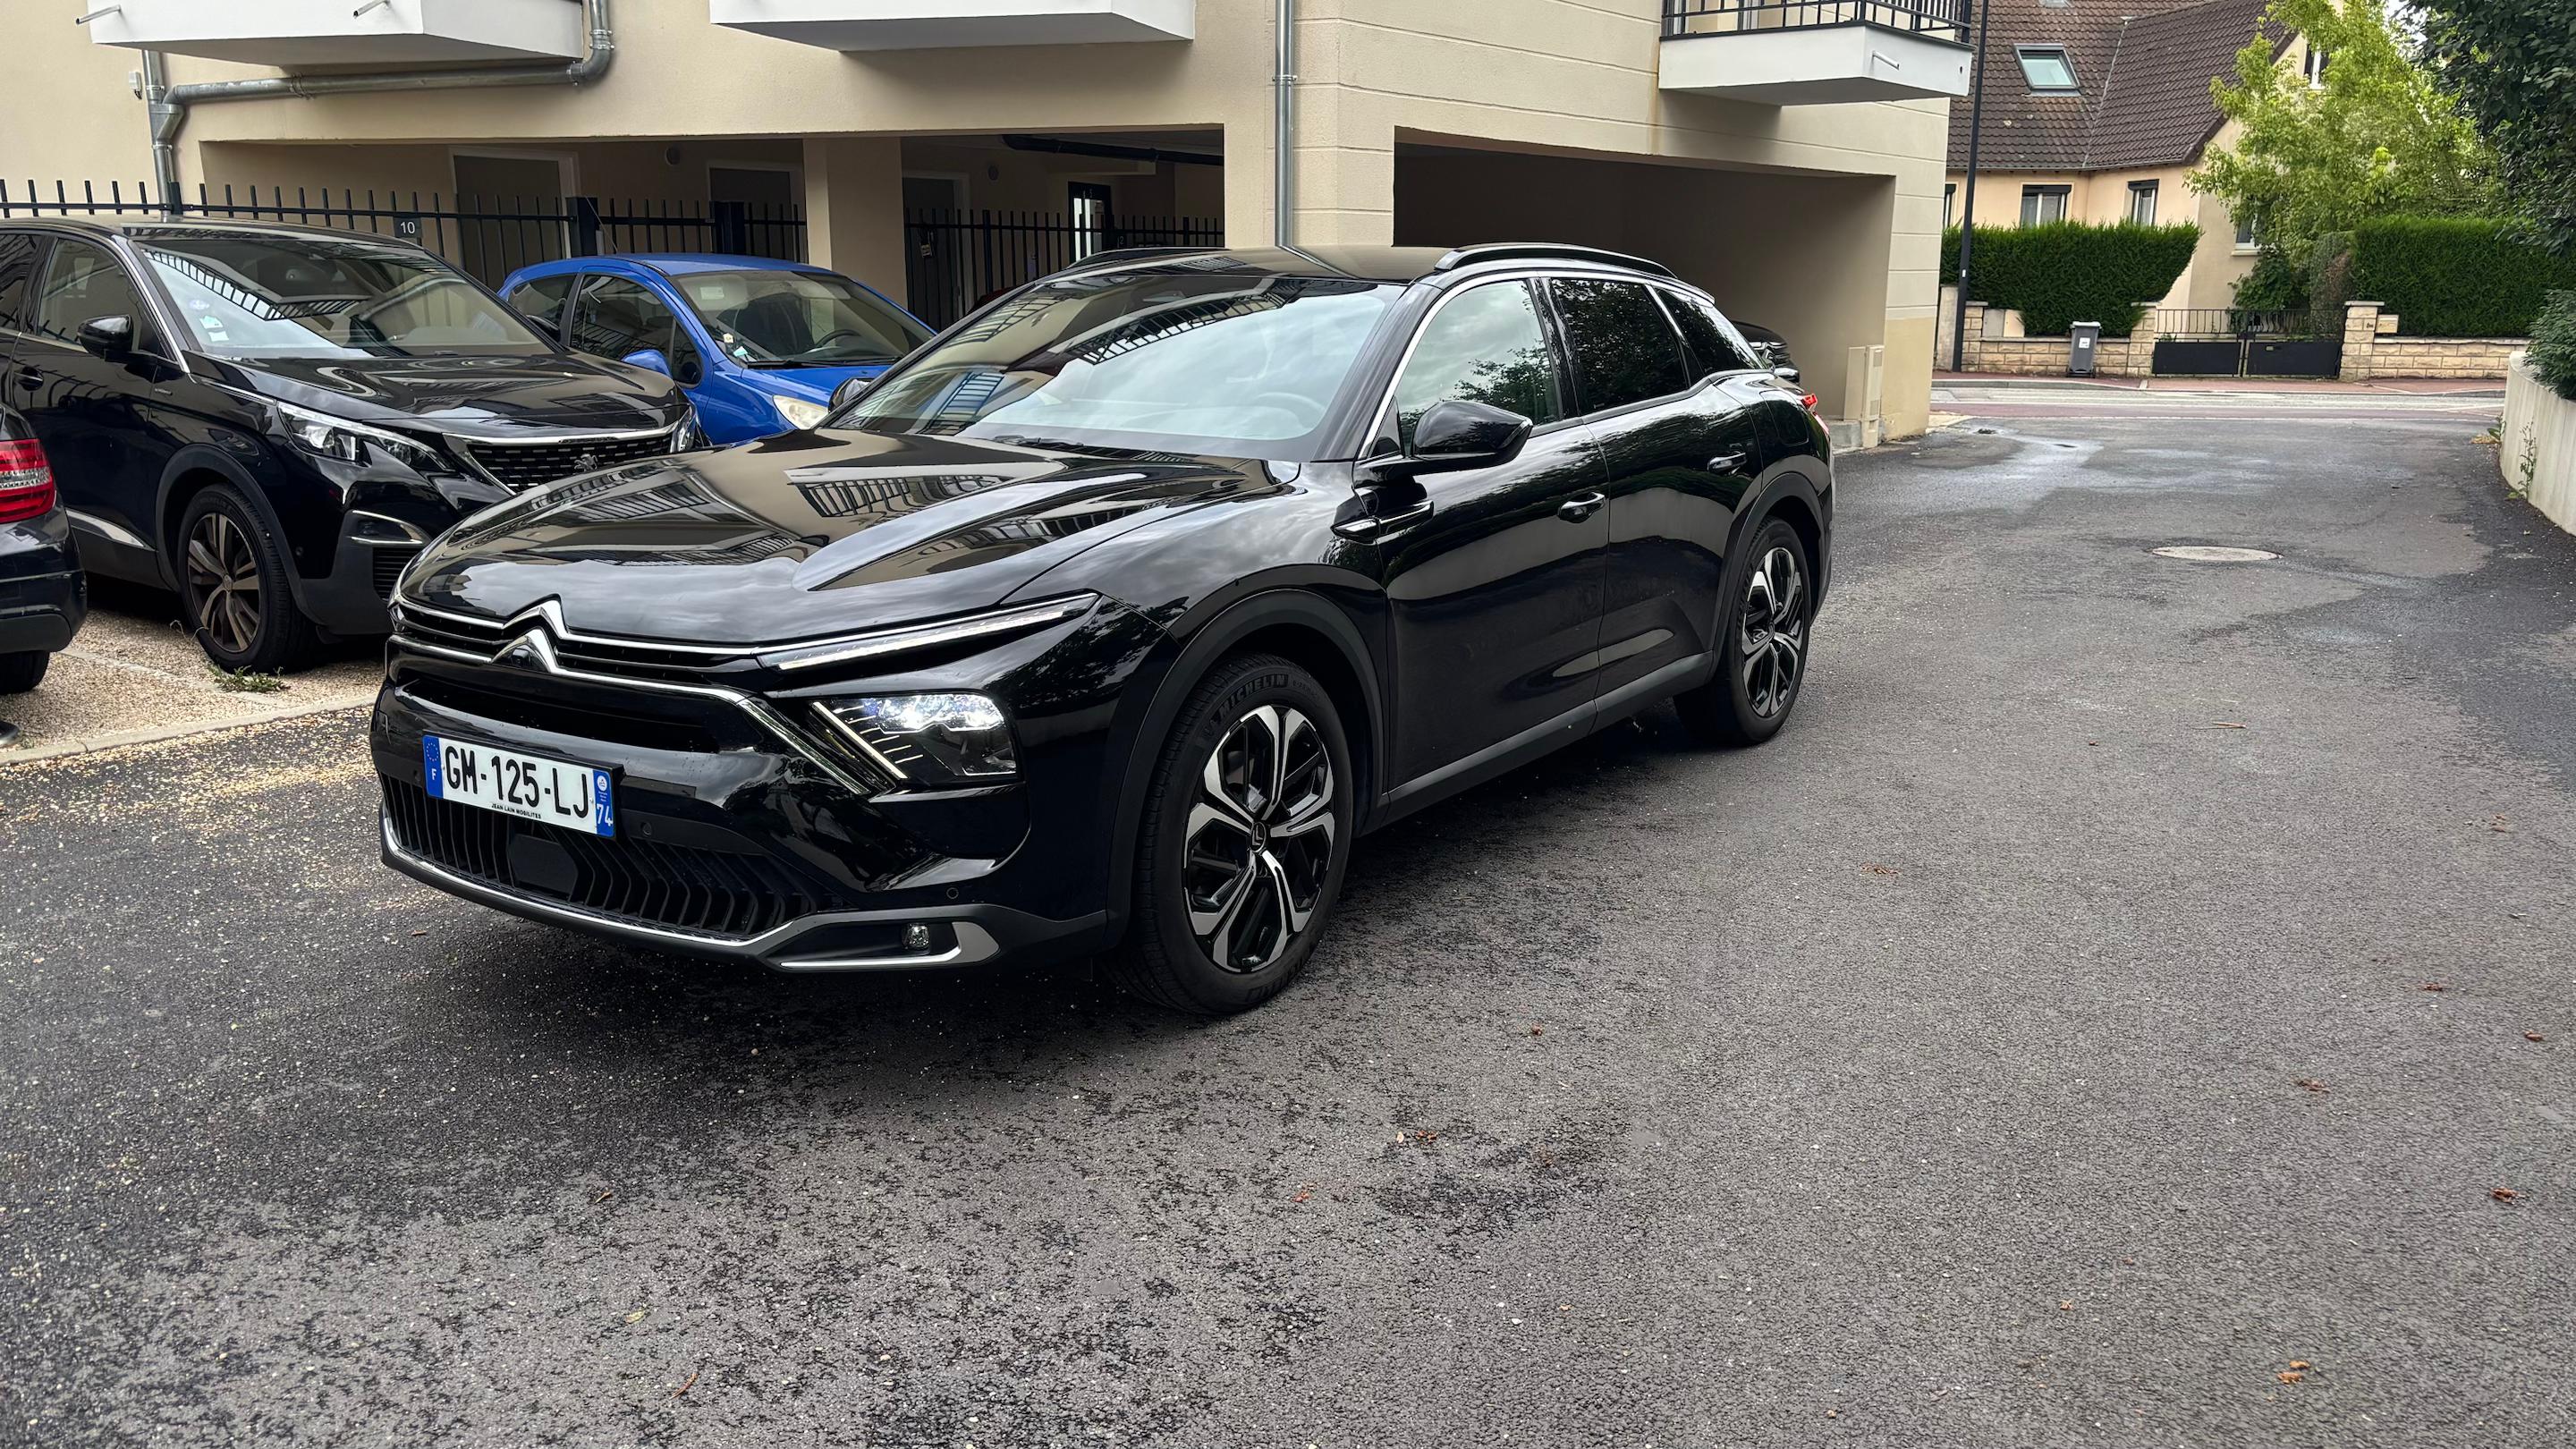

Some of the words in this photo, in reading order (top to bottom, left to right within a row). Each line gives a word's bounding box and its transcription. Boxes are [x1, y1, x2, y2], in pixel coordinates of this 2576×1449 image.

[400, 221, 415, 234] 10
[1218, 674, 1289, 719] MICHELIN
[431, 768, 437, 781] F
[445, 746, 589, 818] GM-125-LJ
[597, 802, 614, 826] 74
